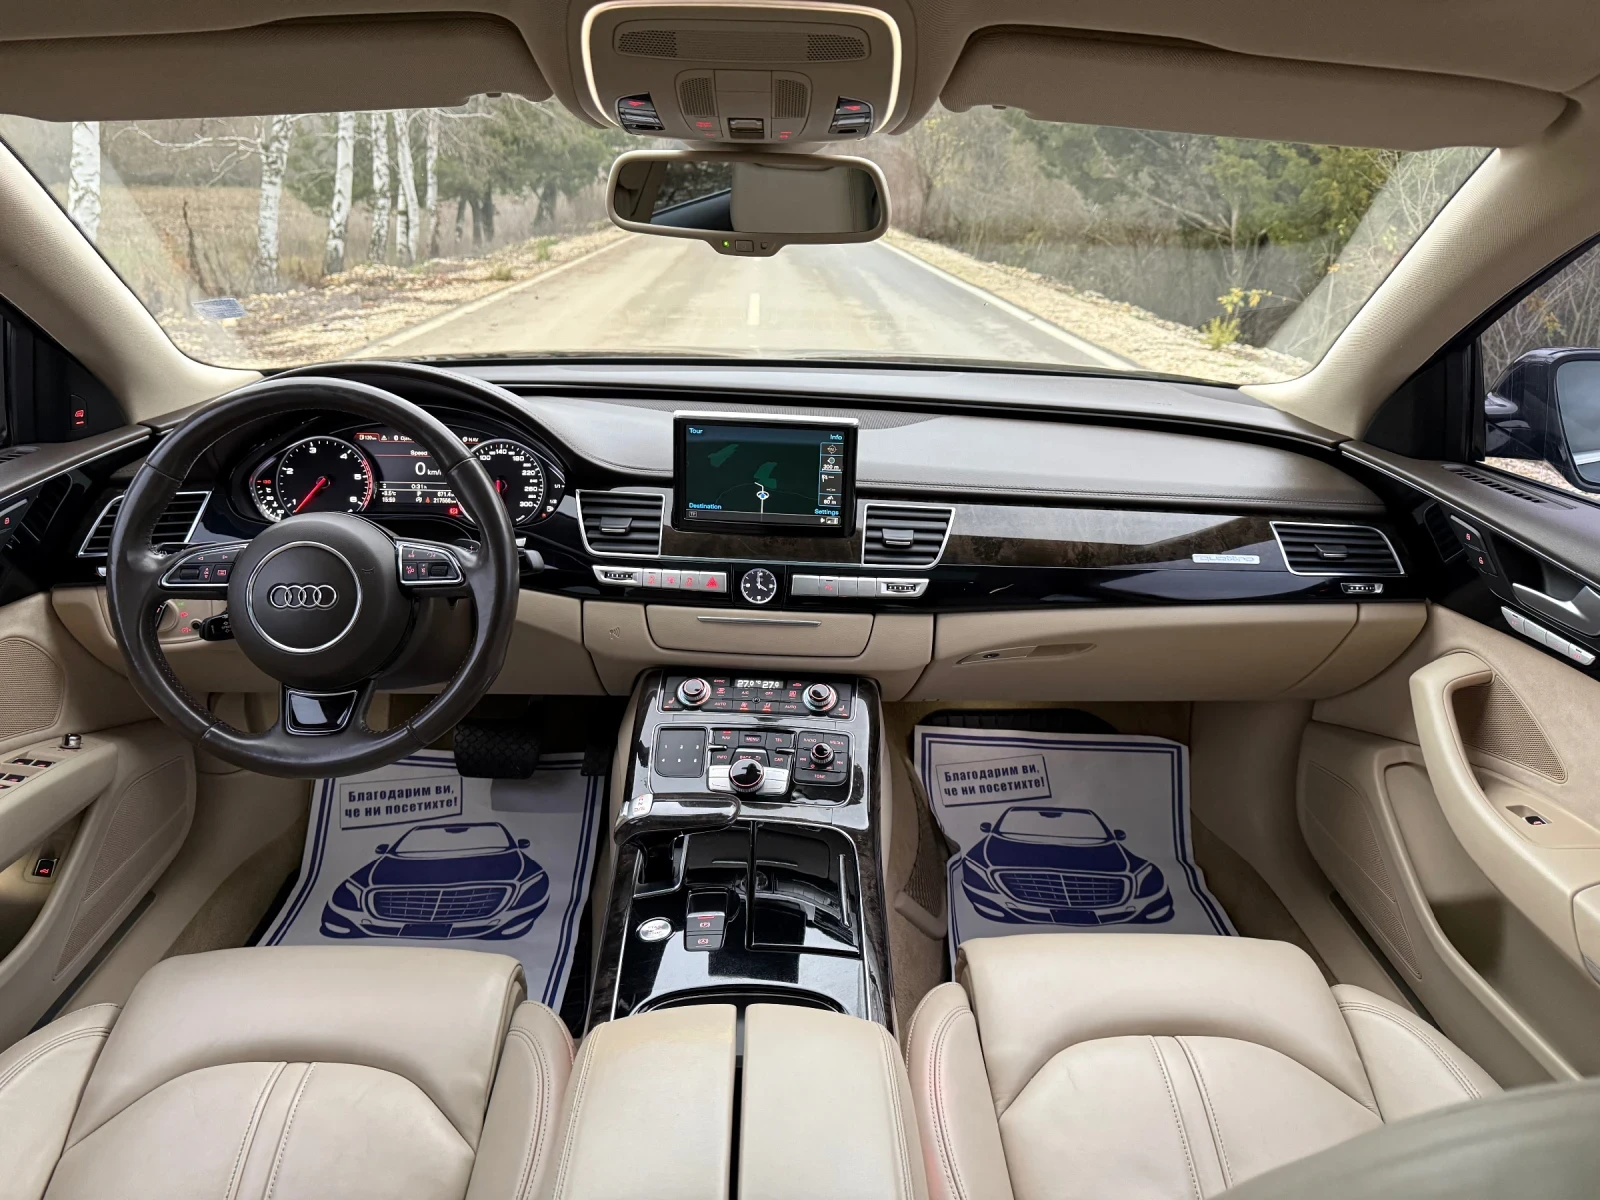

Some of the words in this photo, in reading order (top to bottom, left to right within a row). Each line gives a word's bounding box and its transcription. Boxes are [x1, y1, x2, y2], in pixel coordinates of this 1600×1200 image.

[415, 462, 426, 475] 0
[814, 508, 839, 516] Settings
[944, 766, 1019, 782] Благодарим
[1022, 764, 1040, 774] ви,
[348, 786, 431, 802] Благодарим
[435, 785, 454, 795] ви,
[944, 787, 958, 796] че
[961, 785, 976, 795] ни
[979, 777, 1045, 794] посетихте!
[345, 808, 361, 818] че
[365, 806, 381, 817] ни
[385, 797, 458, 815] посетихте!
